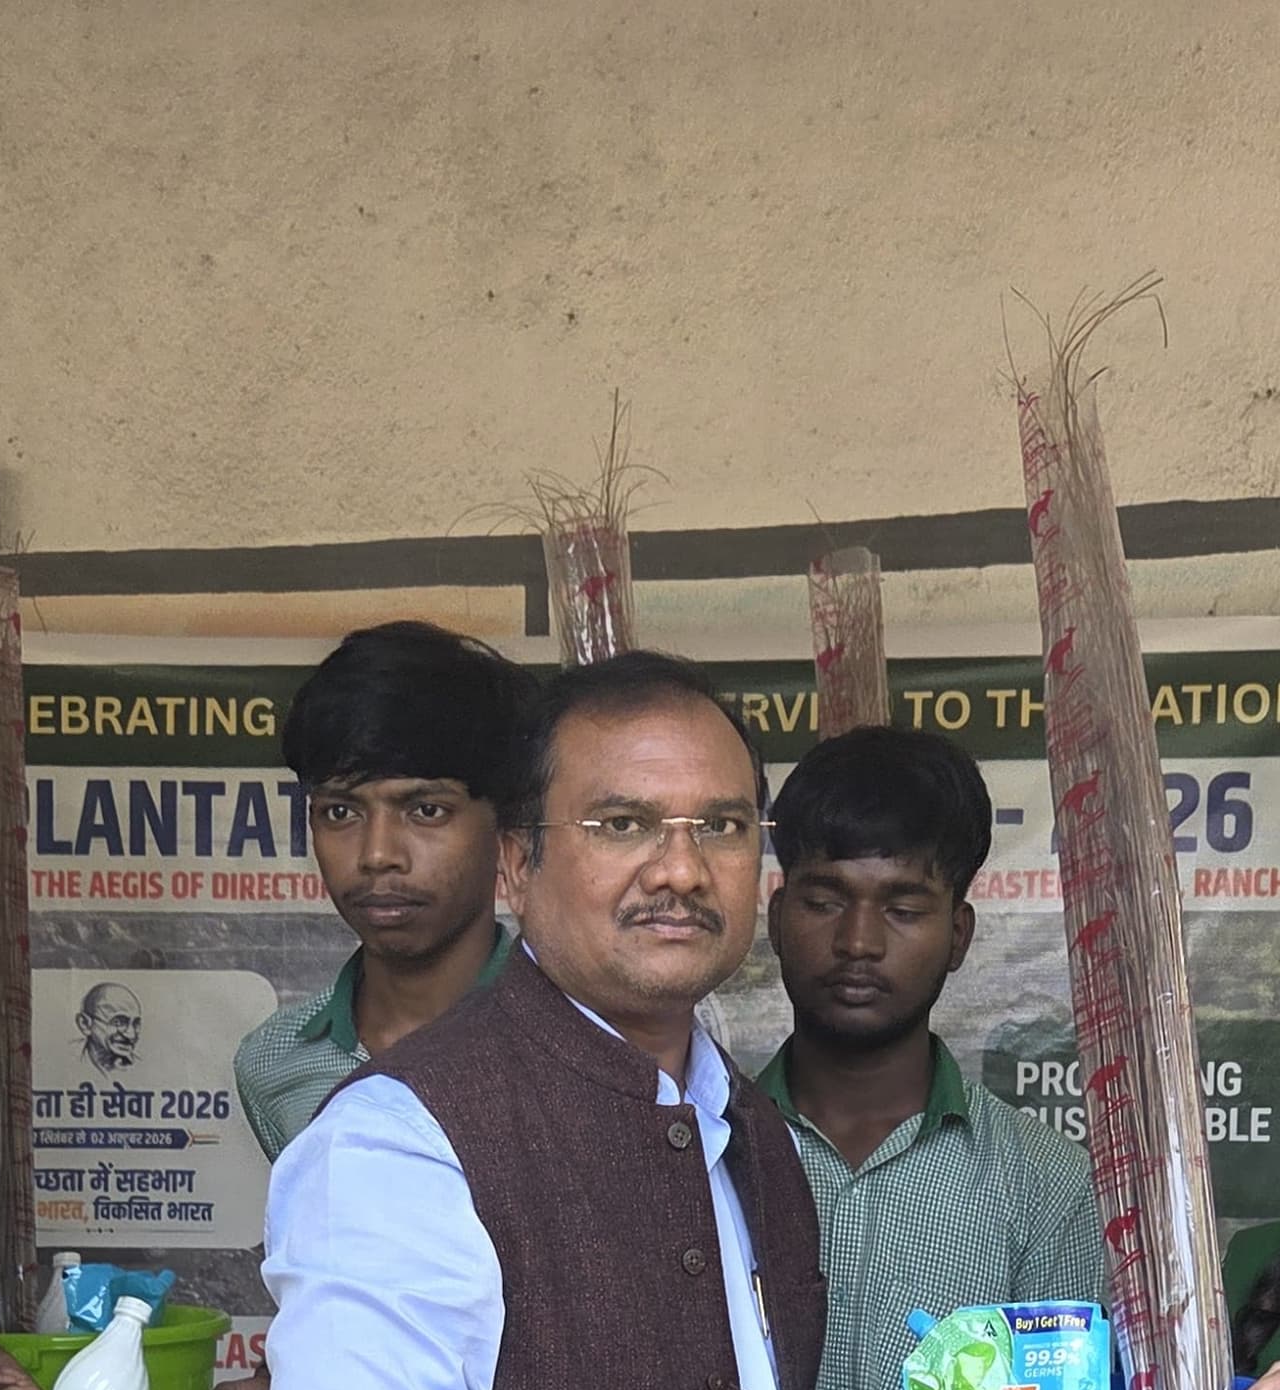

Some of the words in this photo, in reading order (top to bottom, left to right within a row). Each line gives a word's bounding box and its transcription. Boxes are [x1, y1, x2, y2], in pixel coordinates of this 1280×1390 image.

[903, 690, 971, 730] TO
[985, 688, 1045, 728] TH
[35, 779, 309, 858] LANTAT
[32, 870, 83, 897] THE
[89, 871, 164, 898] AEGIS
[171, 871, 204, 899] OF
[211, 872, 327, 900] DIRECTO
[971, 869, 1063, 900] EASTE
[67, 1080, 97, 1119] ही
[100, 1081, 155, 1119] सेवा
[160, 1090, 230, 1120] 2026
[90, 1131, 105, 1145] 02
[144, 1131, 173, 1145] 2026
[34, 1169, 84, 1193] च्छता
[89, 1161, 115, 1193] में
[116, 1169, 196, 1193] सहभाग
[93, 1195, 163, 1222] विकसित
[166, 1201, 215, 1222] भारत
[1015, 1317, 1035, 1332] Buy
[1040, 1315, 1058, 1328] Get
[1064, 1315, 1087, 1330] Free
[1024, 1367, 1064, 1378] GERMS
